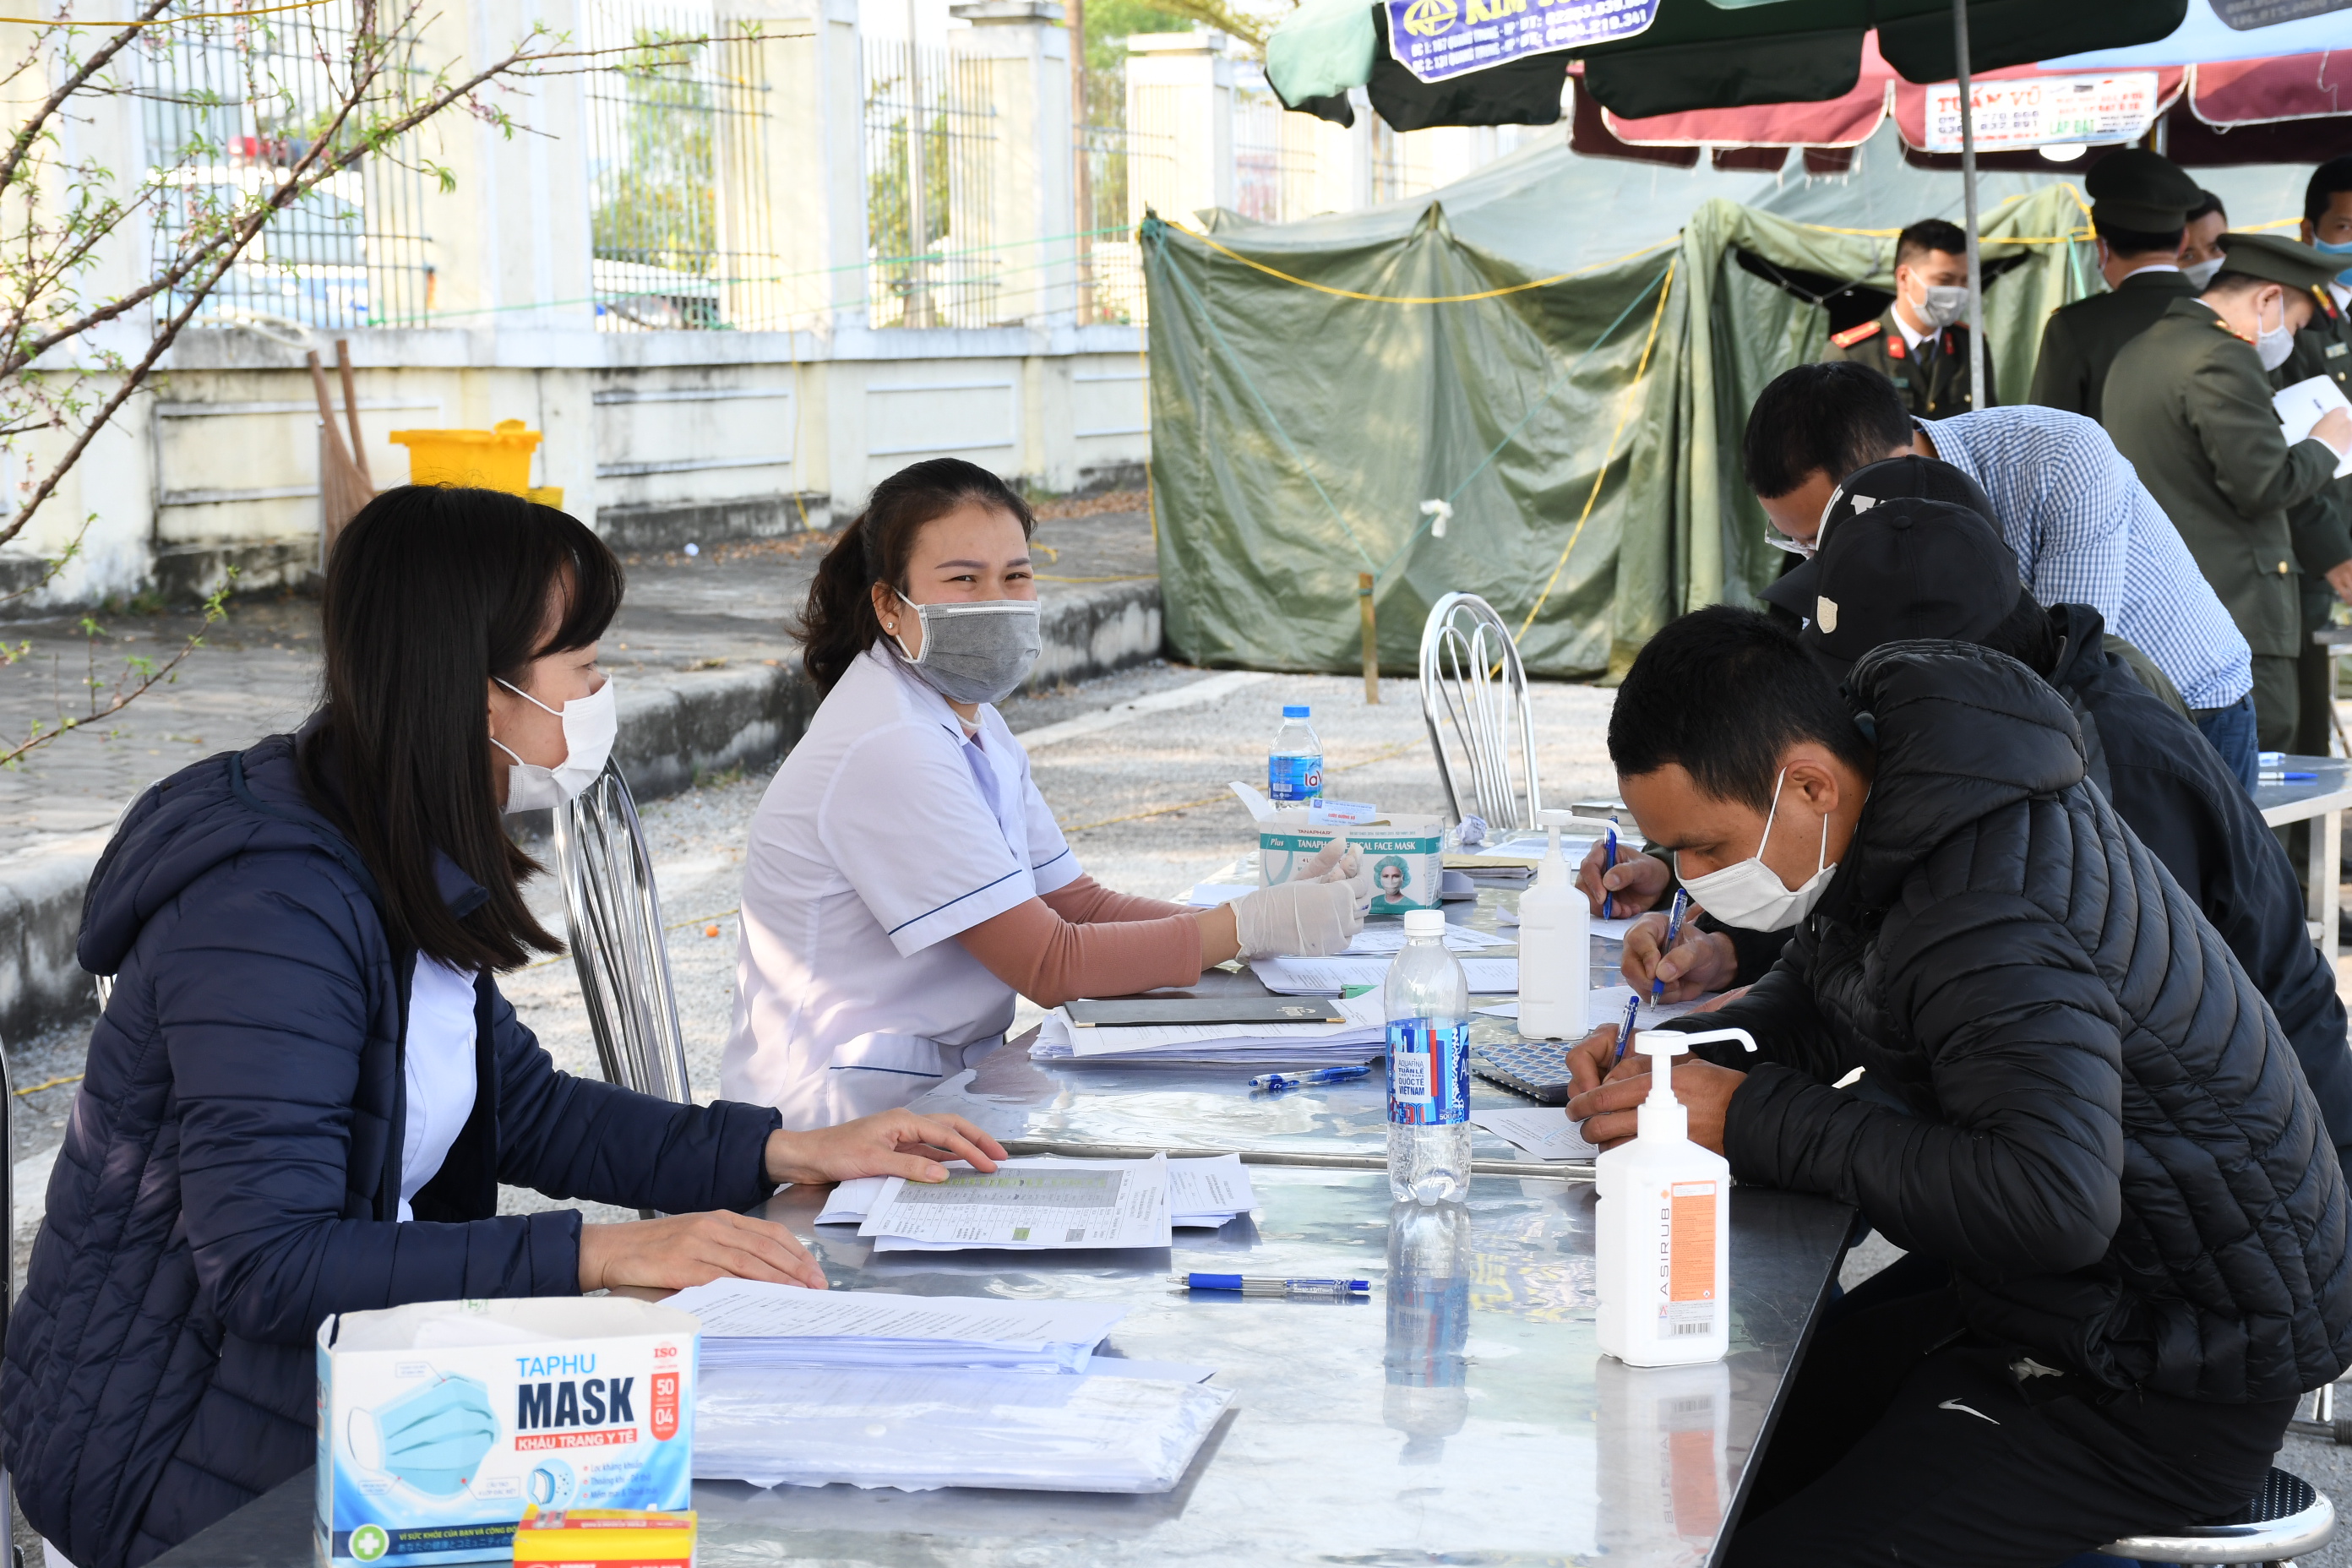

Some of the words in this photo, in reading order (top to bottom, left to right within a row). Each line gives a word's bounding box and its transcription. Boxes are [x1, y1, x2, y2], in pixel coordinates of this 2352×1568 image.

[1270, 838, 1284, 847] Plus
[1298, 839, 1329, 848] TANAPH
[1374, 841, 1393, 850] FACE
[1394, 841, 1416, 850] MASK
[1660, 1207, 1669, 1296] ASIRUB
[654, 1347, 677, 1358] ISO
[515, 1353, 596, 1377] TAPHU
[656, 1378, 674, 1396] 50
[518, 1377, 635, 1429] MASK
[655, 1408, 673, 1425] 04
[559, 1434, 604, 1447] TRANG
[606, 1433, 616, 1444] Y
